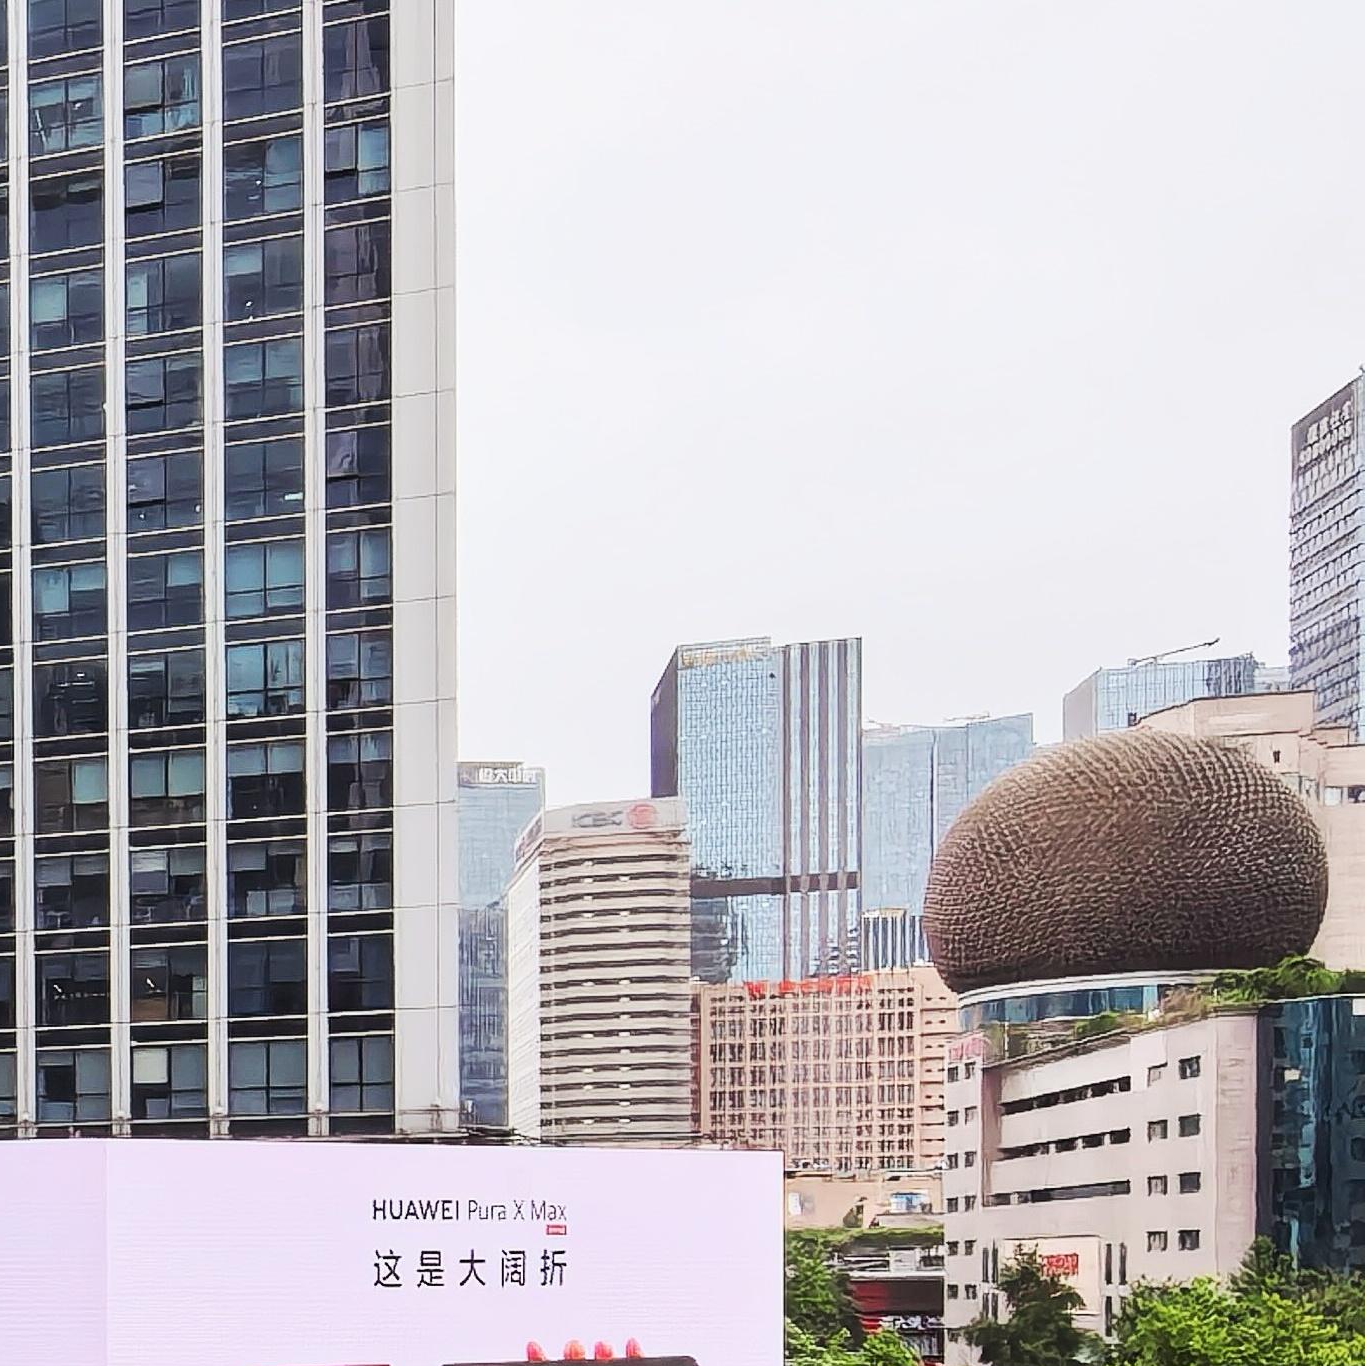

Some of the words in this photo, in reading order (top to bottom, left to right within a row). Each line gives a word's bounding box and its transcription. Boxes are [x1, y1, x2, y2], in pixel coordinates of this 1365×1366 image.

[373, 1199, 459, 1220] HUAWEI
[468, 1200, 506, 1220] Pura
[513, 1199, 525, 1220] X
[531, 1199, 567, 1221] Max
[374, 1249, 567, 1287] 这是大阔折
